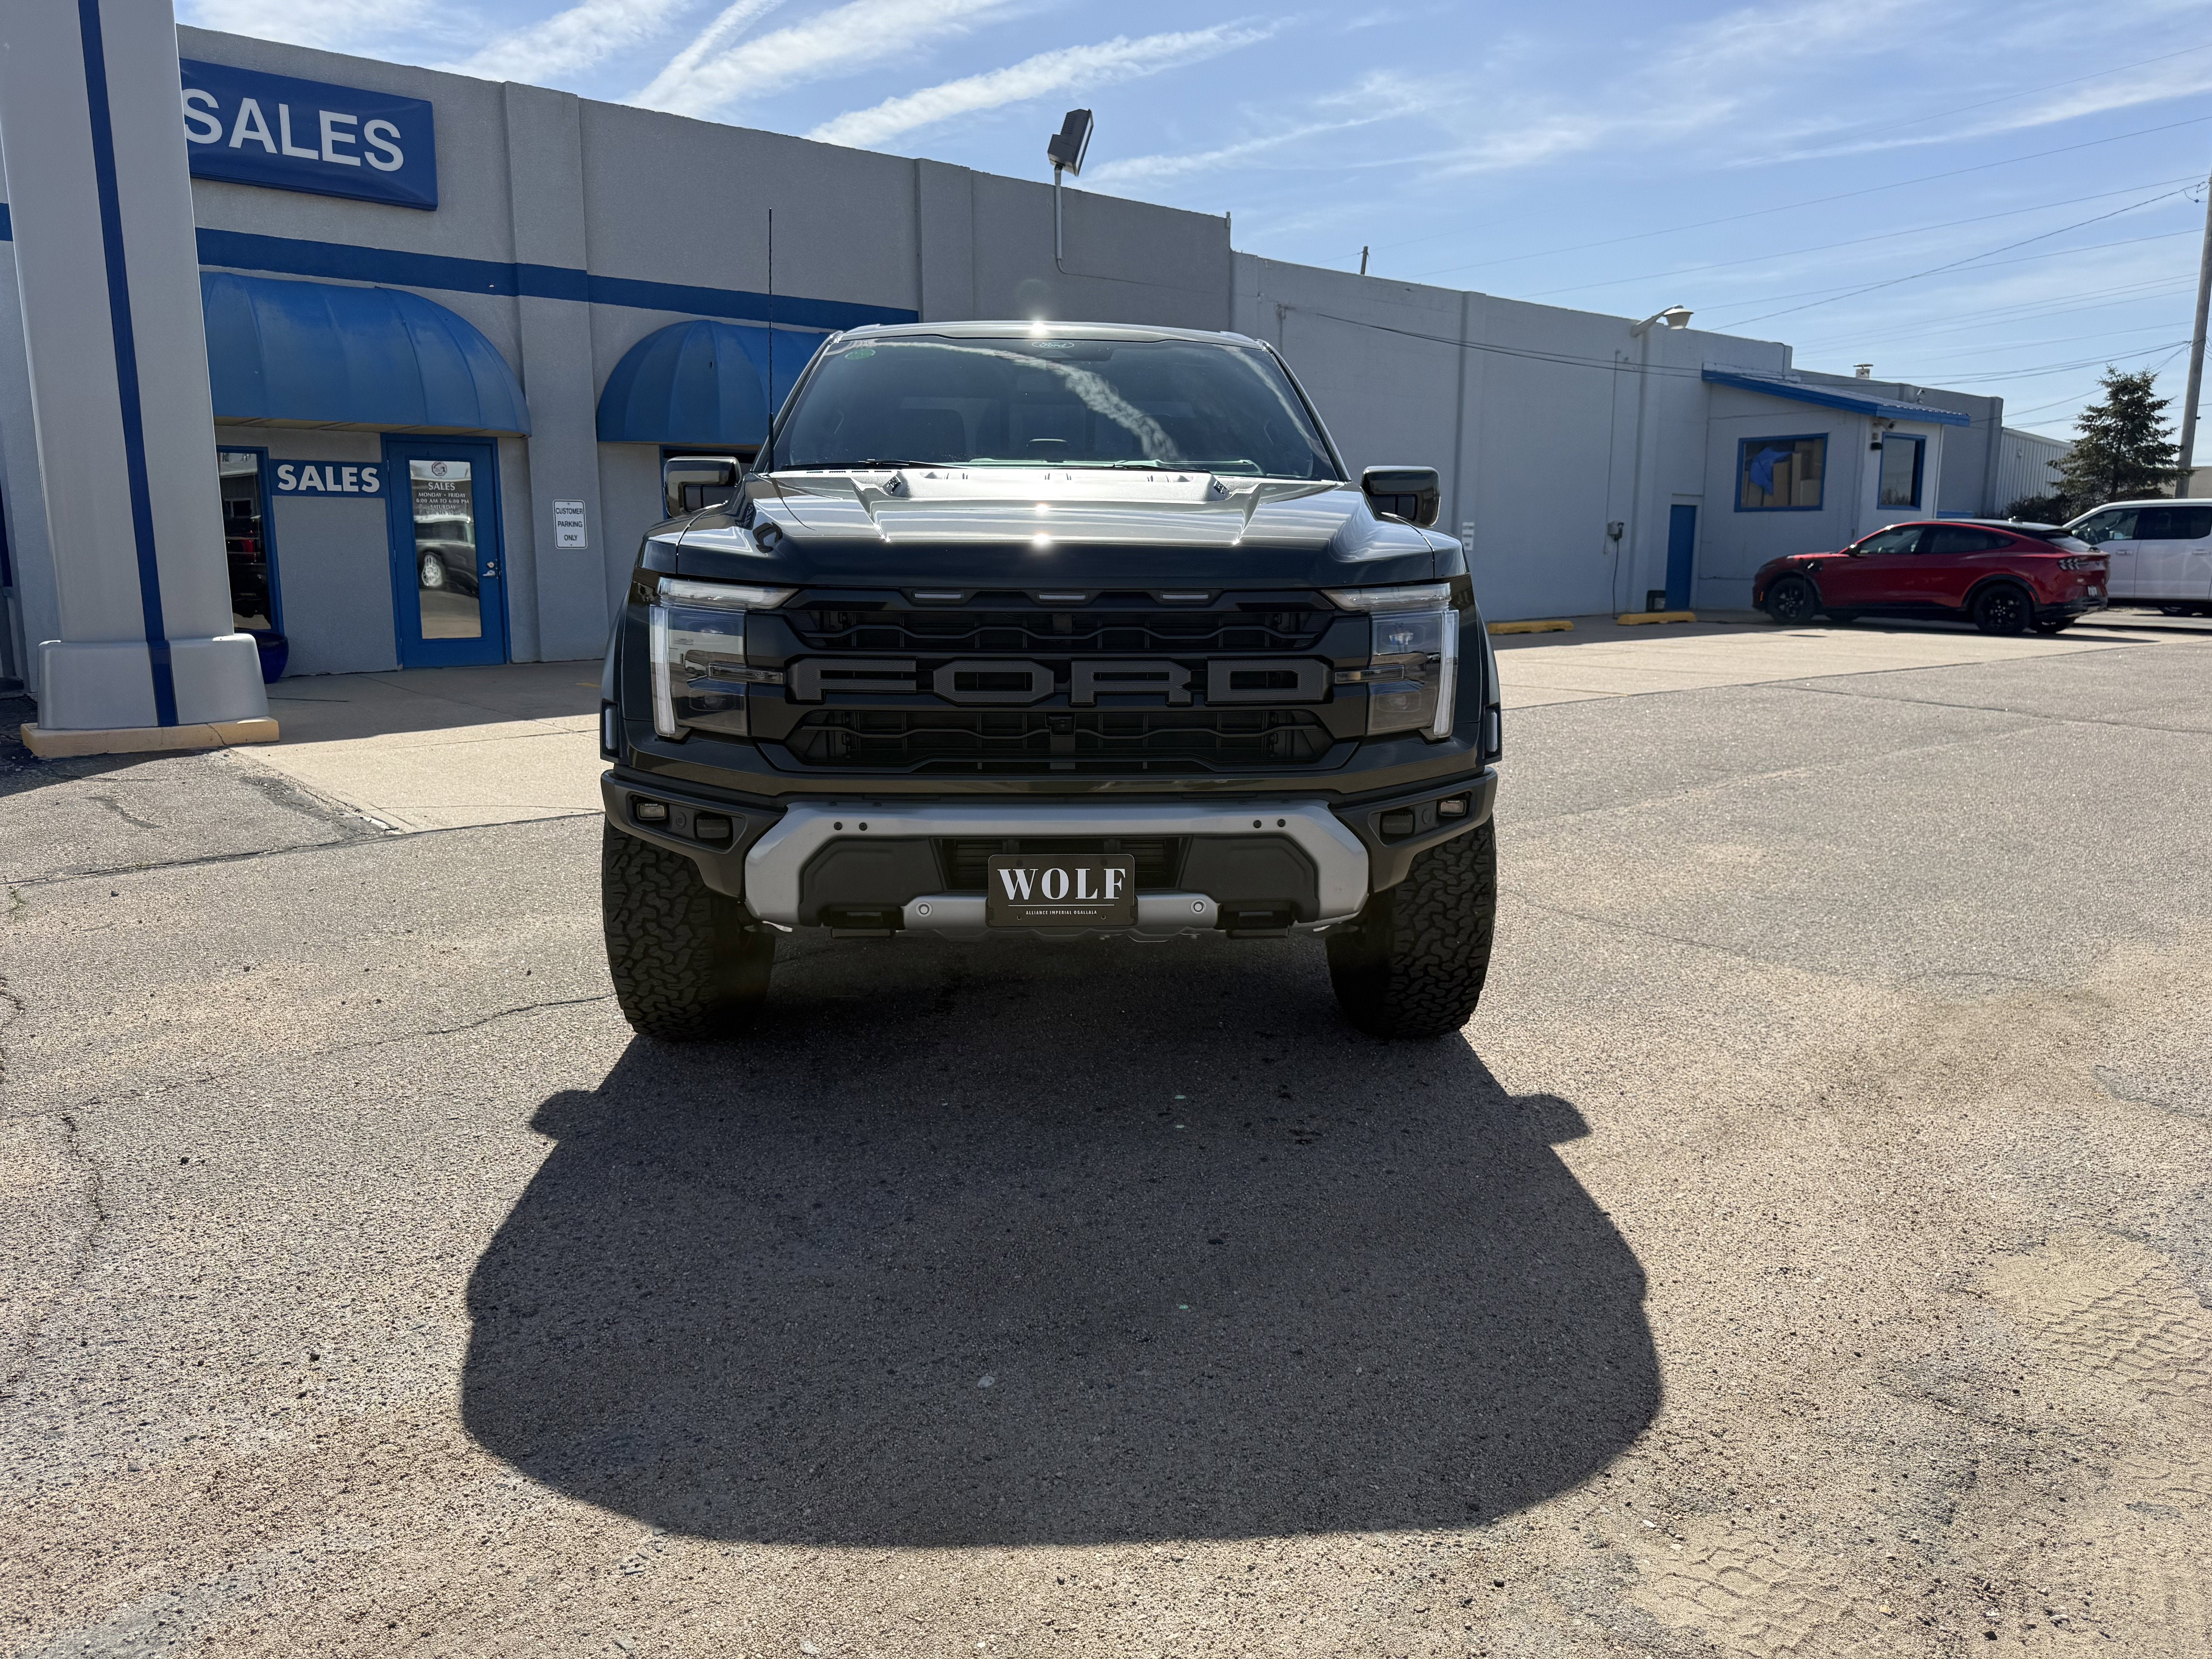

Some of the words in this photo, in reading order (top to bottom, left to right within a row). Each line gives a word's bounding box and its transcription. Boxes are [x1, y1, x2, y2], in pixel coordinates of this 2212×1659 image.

[182, 88, 404, 172] SALES
[277, 464, 380, 493] SALES
[428, 482, 455, 491] SALES
[790, 659, 1328, 704] FORD
[997, 868, 1126, 900] WOLF
